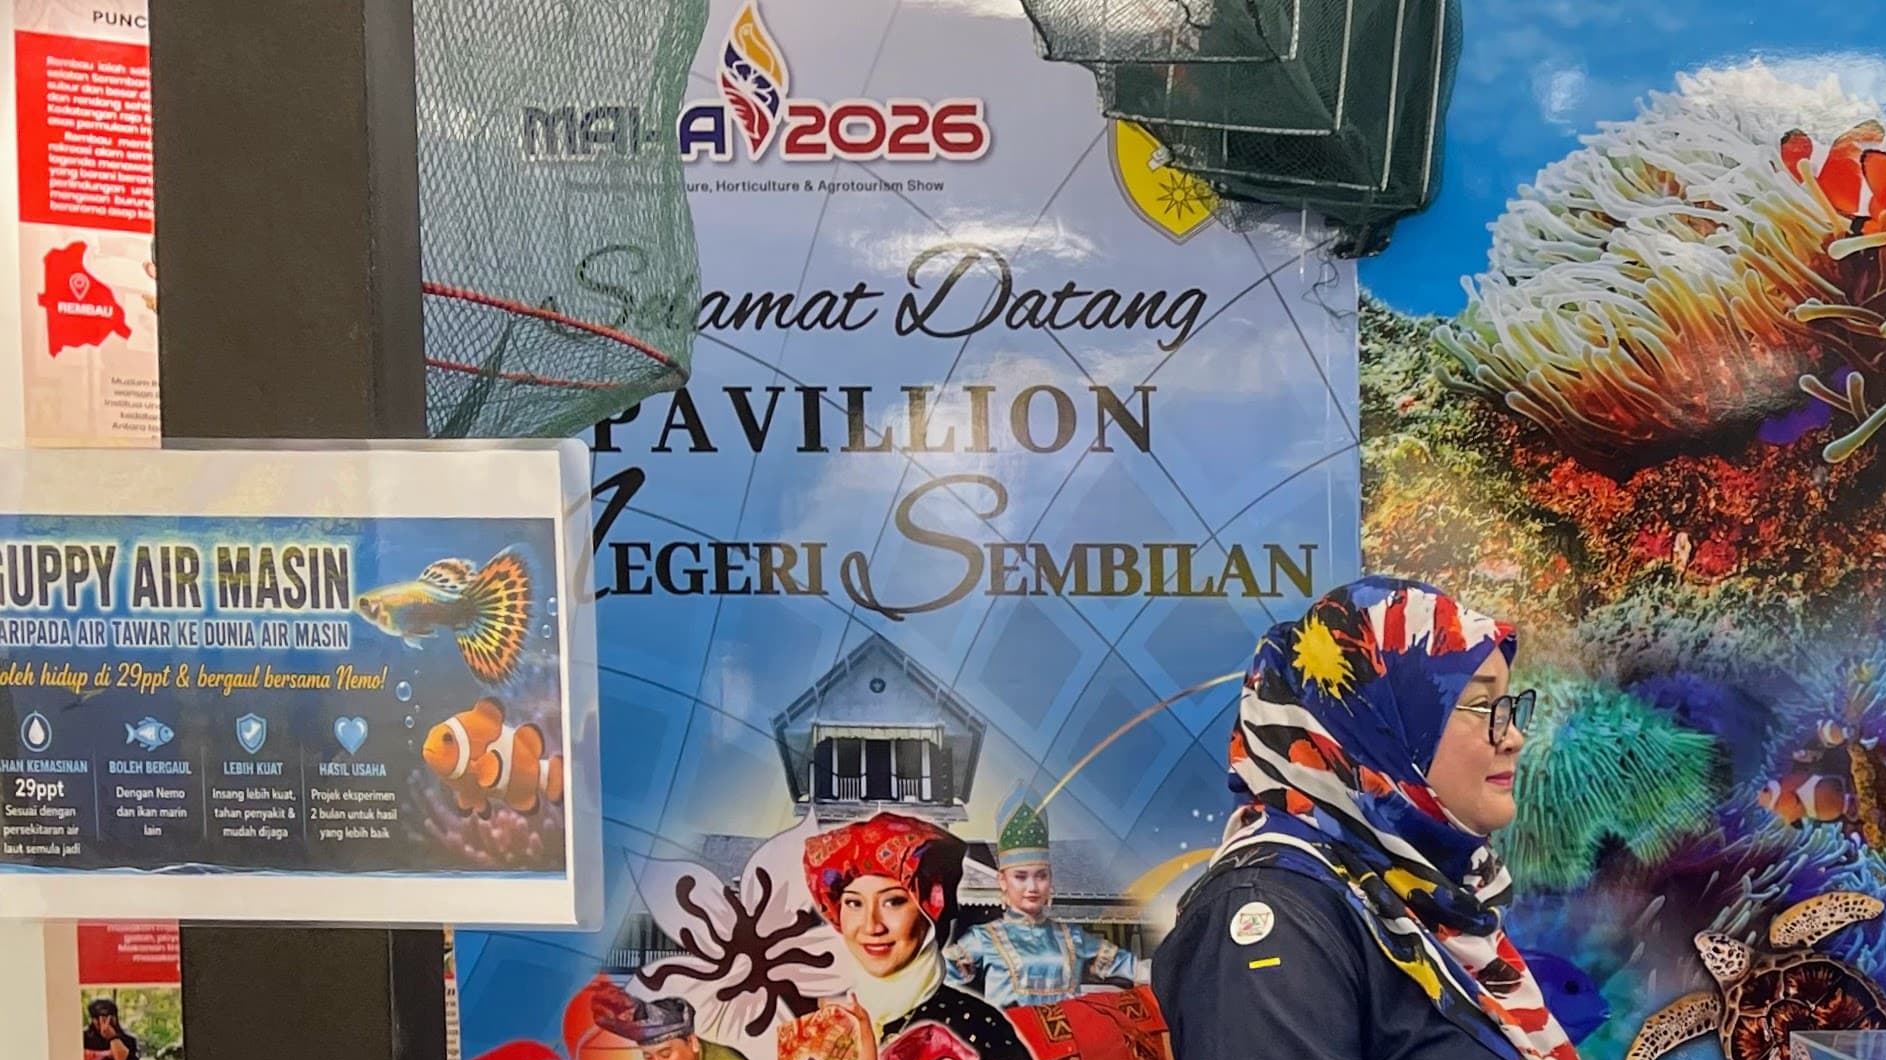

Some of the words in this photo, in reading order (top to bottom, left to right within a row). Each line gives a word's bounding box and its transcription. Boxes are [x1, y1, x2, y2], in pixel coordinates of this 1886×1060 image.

[786, 104, 985, 155] 2026
[715, 180, 800, 193] Horticulture
[804, 181, 813, 192] &
[818, 180, 902, 195] Agrotourism
[907, 180, 944, 192] Show
[895, 242, 1207, 351] Datang
[58, 301, 113, 318] REMBAU
[840, 474, 1318, 622] SEMBILAN
[132, 545, 202, 609] AIR
[216, 546, 350, 610] MASIN
[78, 620, 106, 645] AIR
[112, 620, 171, 646] TAWAR
[178, 621, 198, 646] KE
[204, 621, 256, 647] DUNIA
[261, 622, 289, 648] AIR
[295, 622, 348, 648] MASIN
[40, 662, 89, 695] hidup
[94, 662, 112, 687] di
[116, 662, 171, 695] 29ppt
[175, 663, 190, 688] &
[197, 663, 261, 696] bergaul
[263, 664, 331, 689] bersama
[335, 664, 389, 690] Nemo!
[0, 760, 24, 773] HAN
[27, 760, 88, 773] KEMASINAN
[109, 760, 143, 774] BOLEH
[146, 761, 192, 775] BERGAUL
[223, 761, 253, 775] LEBIH
[256, 762, 283, 776] KUAT
[319, 762, 350, 776] HASIL
[352, 763, 386, 777] USAHA
[15, 778, 65, 801] 29ppt
[116, 786, 153, 801] Dengan
[156, 787, 185, 799] Nemo
[212, 788, 245, 802] Insang
[246, 788, 270, 801] lebih
[311, 788, 341, 803] Projek
[342, 789, 395, 803] eksperimen
[5, 804, 37, 817] Sesuai
[39, 805, 76, 820] dengan
[116, 805, 136, 818] dan
[137, 806, 158, 818] ikan
[160, 806, 187, 818] marin
[214, 807, 242, 819] tahan
[244, 807, 286, 822] penyakit
[288, 808, 296, 819] &
[310, 808, 317, 819] 2
[319, 807, 346, 820] bulan
[347, 807, 374, 820] untuk
[376, 808, 397, 820] hasil
[3, 824, 64, 838] persekitaran
[66, 824, 80, 836] air
[143, 824, 162, 836] lain
[223, 825, 256, 837] mudah
[258, 826, 289, 840] dijaga
[319, 827, 343, 841] yang
[345, 826, 369, 839] lebih
[370, 826, 390, 839] baik
[4, 843, 23, 855] laut
[26, 843, 61, 855] semula
[62, 843, 81, 857] jadi
